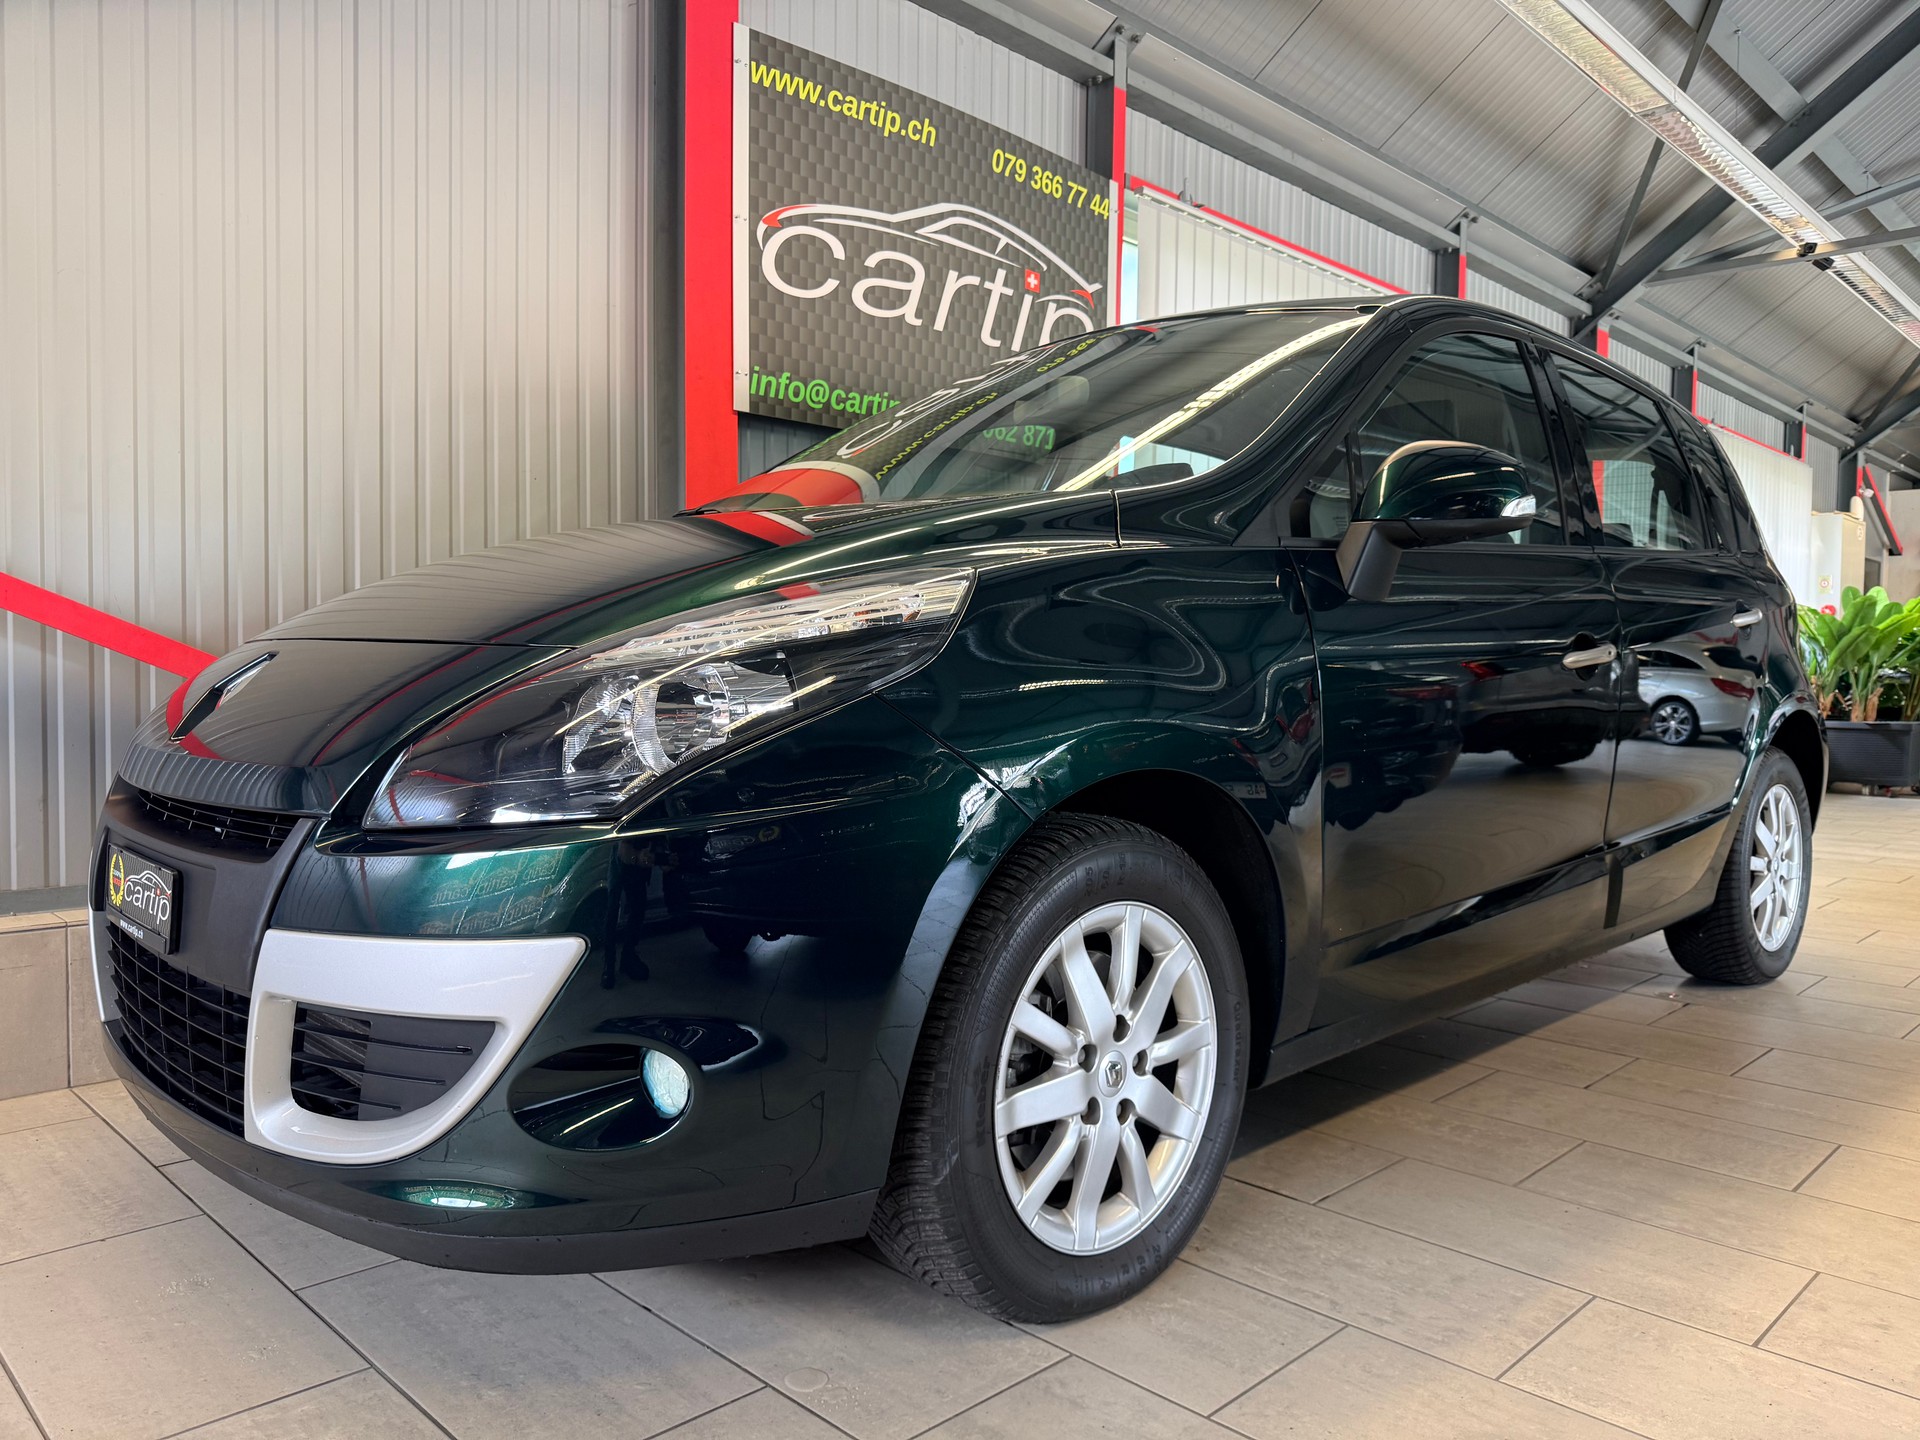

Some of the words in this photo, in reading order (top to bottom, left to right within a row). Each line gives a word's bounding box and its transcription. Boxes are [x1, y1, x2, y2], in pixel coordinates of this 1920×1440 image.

[750, 60, 937, 147] www.cartip.ch
[991, 148, 1027, 183] 079
[1030, 165, 1063, 199] 366
[1067, 180, 1088, 209] 77
[1089, 193, 1109, 220] 44
[750, 365, 901, 416] info@carti
[1022, 425, 1056, 450] 871
[124, 881, 170, 924] cartip
